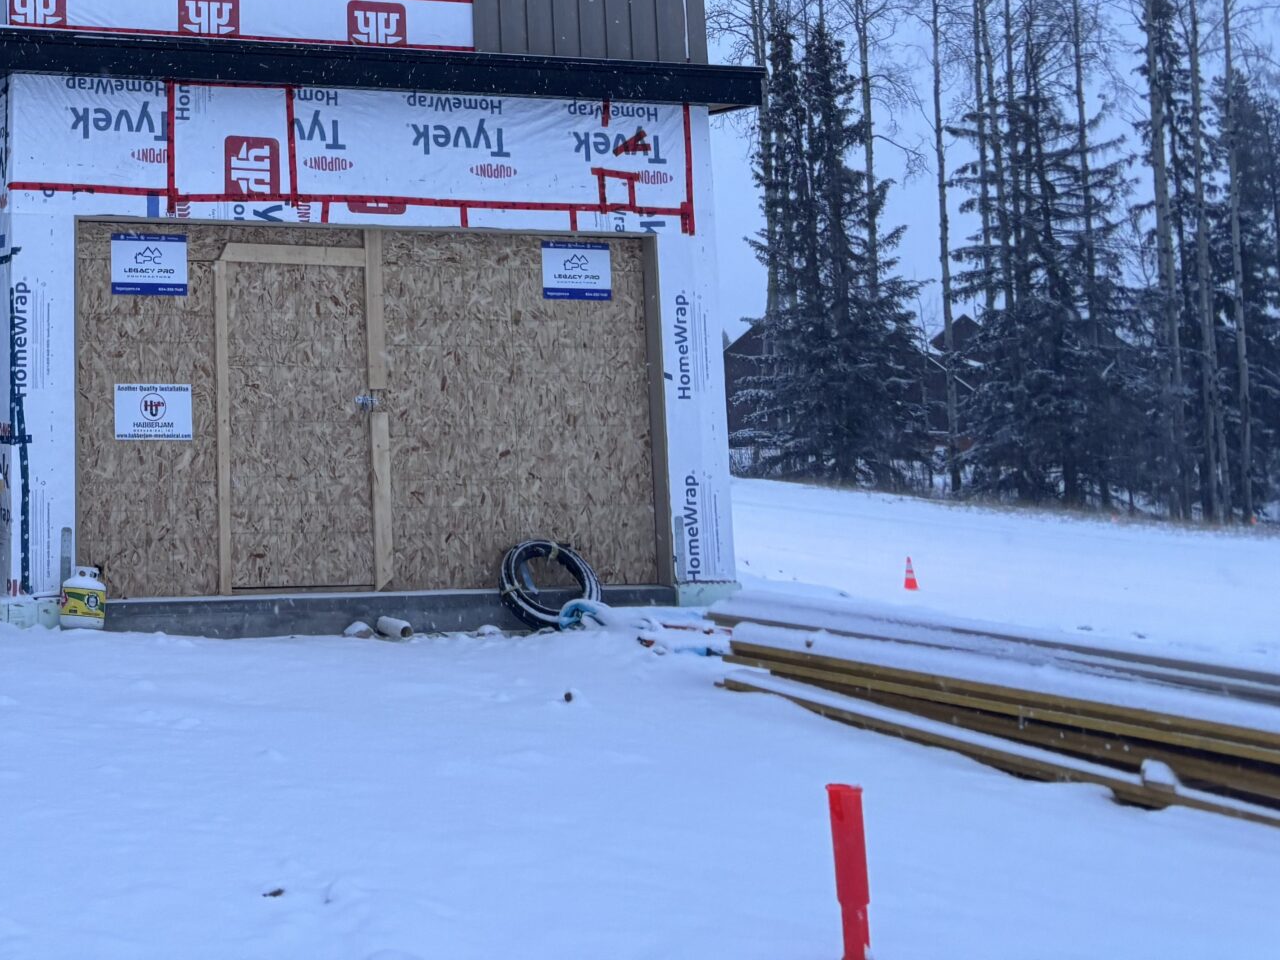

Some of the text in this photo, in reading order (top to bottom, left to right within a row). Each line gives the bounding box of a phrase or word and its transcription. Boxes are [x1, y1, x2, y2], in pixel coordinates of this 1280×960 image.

[407, 90, 502, 115] HomeWrap
[411, 118, 510, 158] Tyvek
[309, 156, 348, 171] DUPONT
[475, 163, 512, 179] DUPONT
[14, 281, 31, 397] HomeWrap
[674, 292, 689, 400] HomeWrap
[684, 477, 701, 582] HomeWrap
